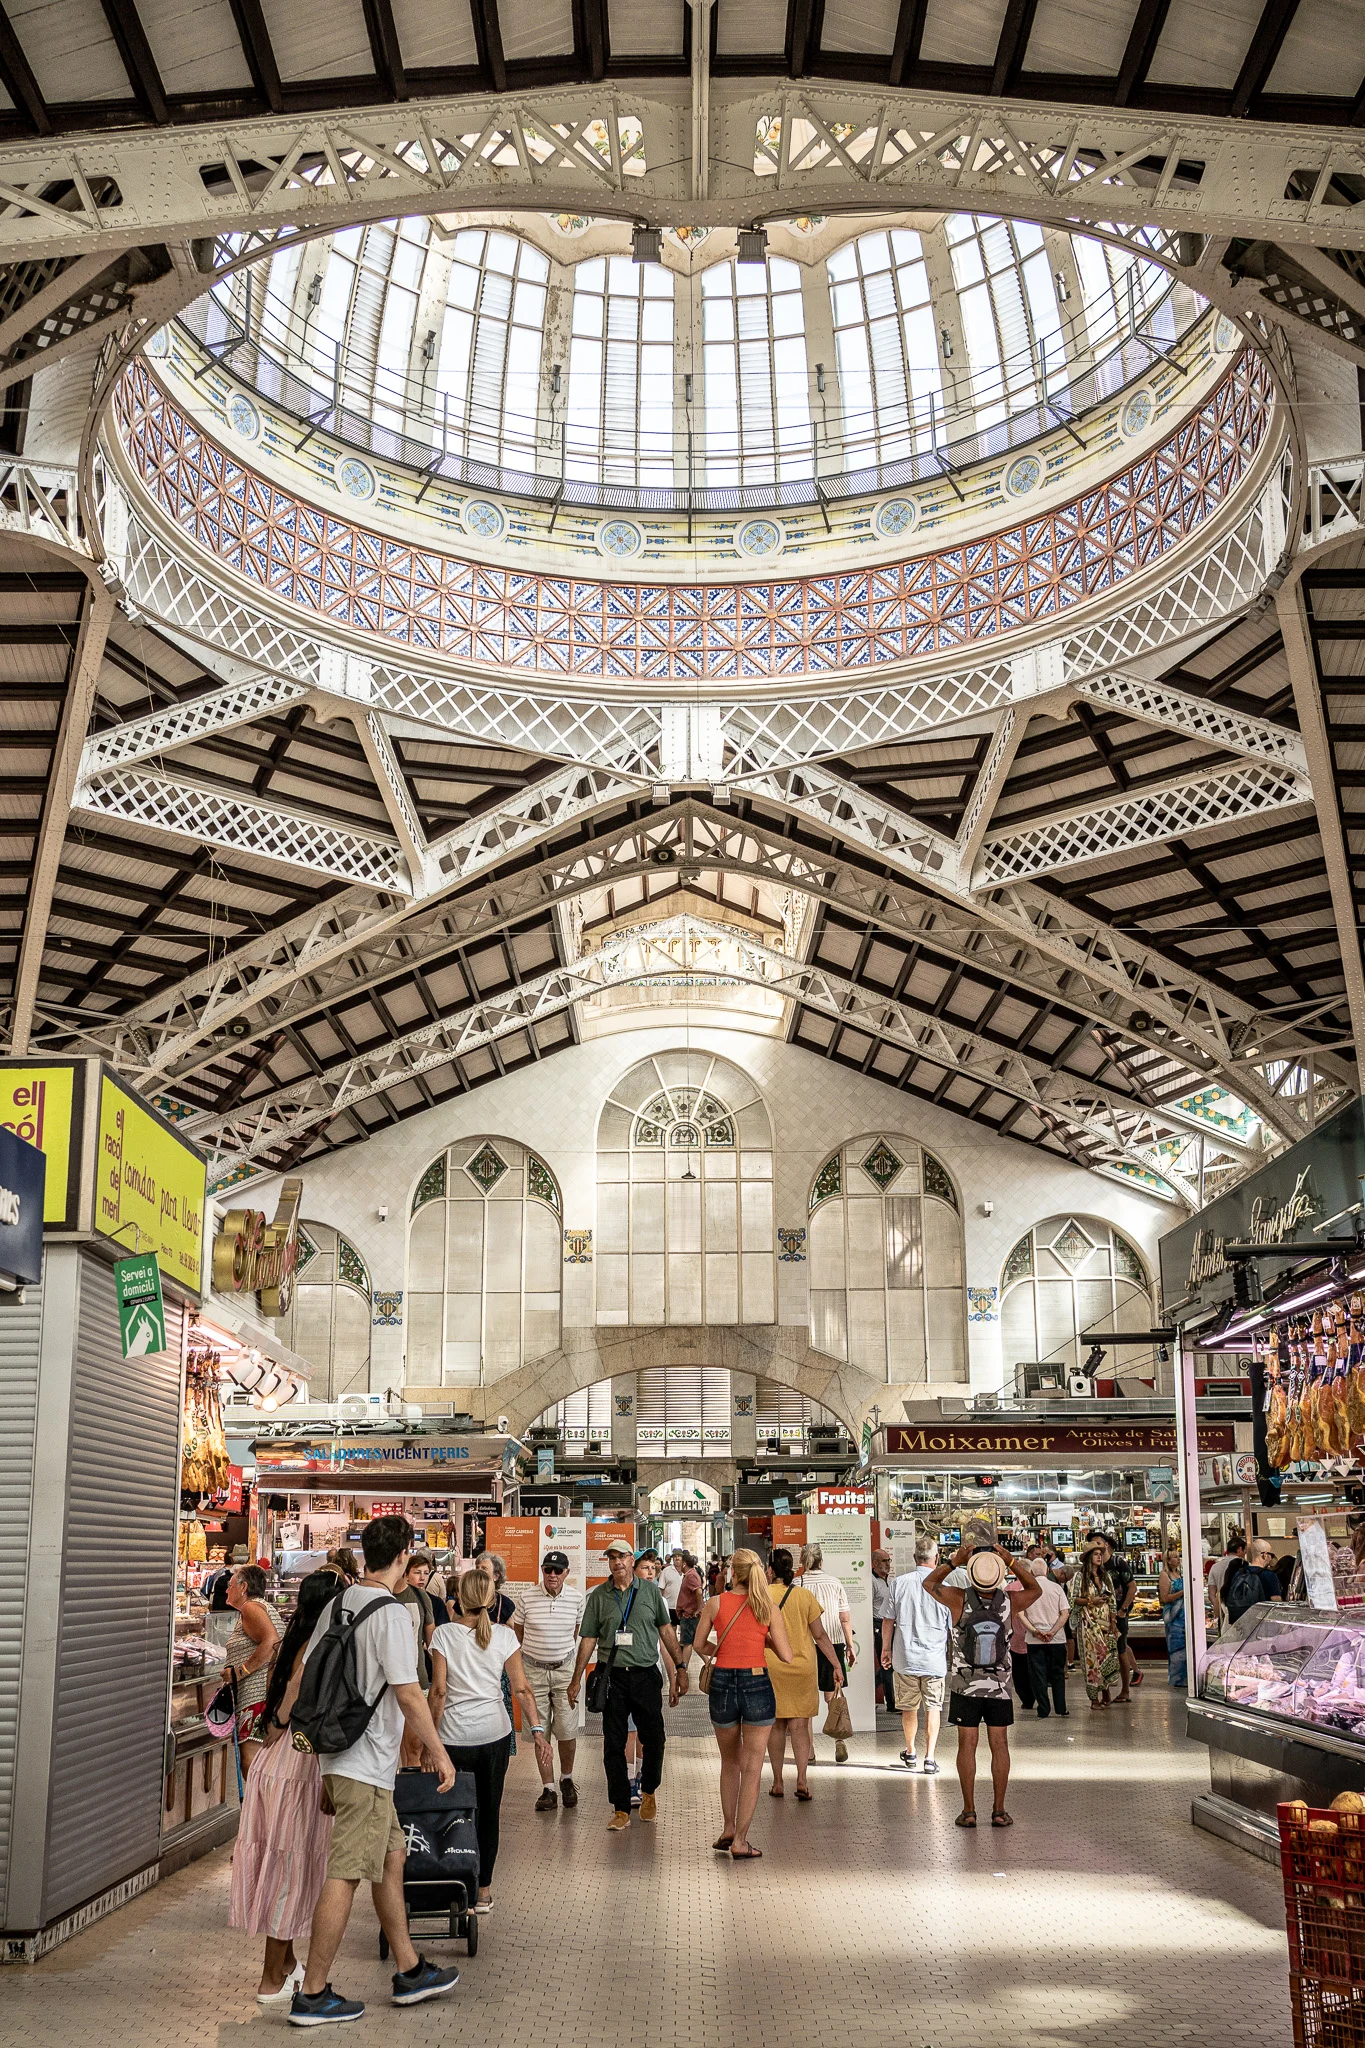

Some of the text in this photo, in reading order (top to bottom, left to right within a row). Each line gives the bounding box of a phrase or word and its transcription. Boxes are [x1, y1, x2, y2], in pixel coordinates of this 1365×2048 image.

[13, 1081, 38, 1107] el
[104, 1133, 121, 1160] racó
[109, 1166, 120, 1191] de
[124, 1160, 156, 1205] comidas
[159, 1187, 178, 1228] para
[182, 1195, 201, 1238] llevar
[121, 1265, 146, 1283] Servei
[123, 1279, 155, 1297] domicili
[897, 1430, 1055, 1450] Moixamer
[1065, 1429, 1119, 1438] Artesà
[1125, 1429, 1144, 1438] de
[1082, 1438, 1133, 1447] Olives
[1138, 1438, 1143, 1447] i
[982, 1476, 993, 1485] 98
[820, 1490, 865, 1505] Fruits
